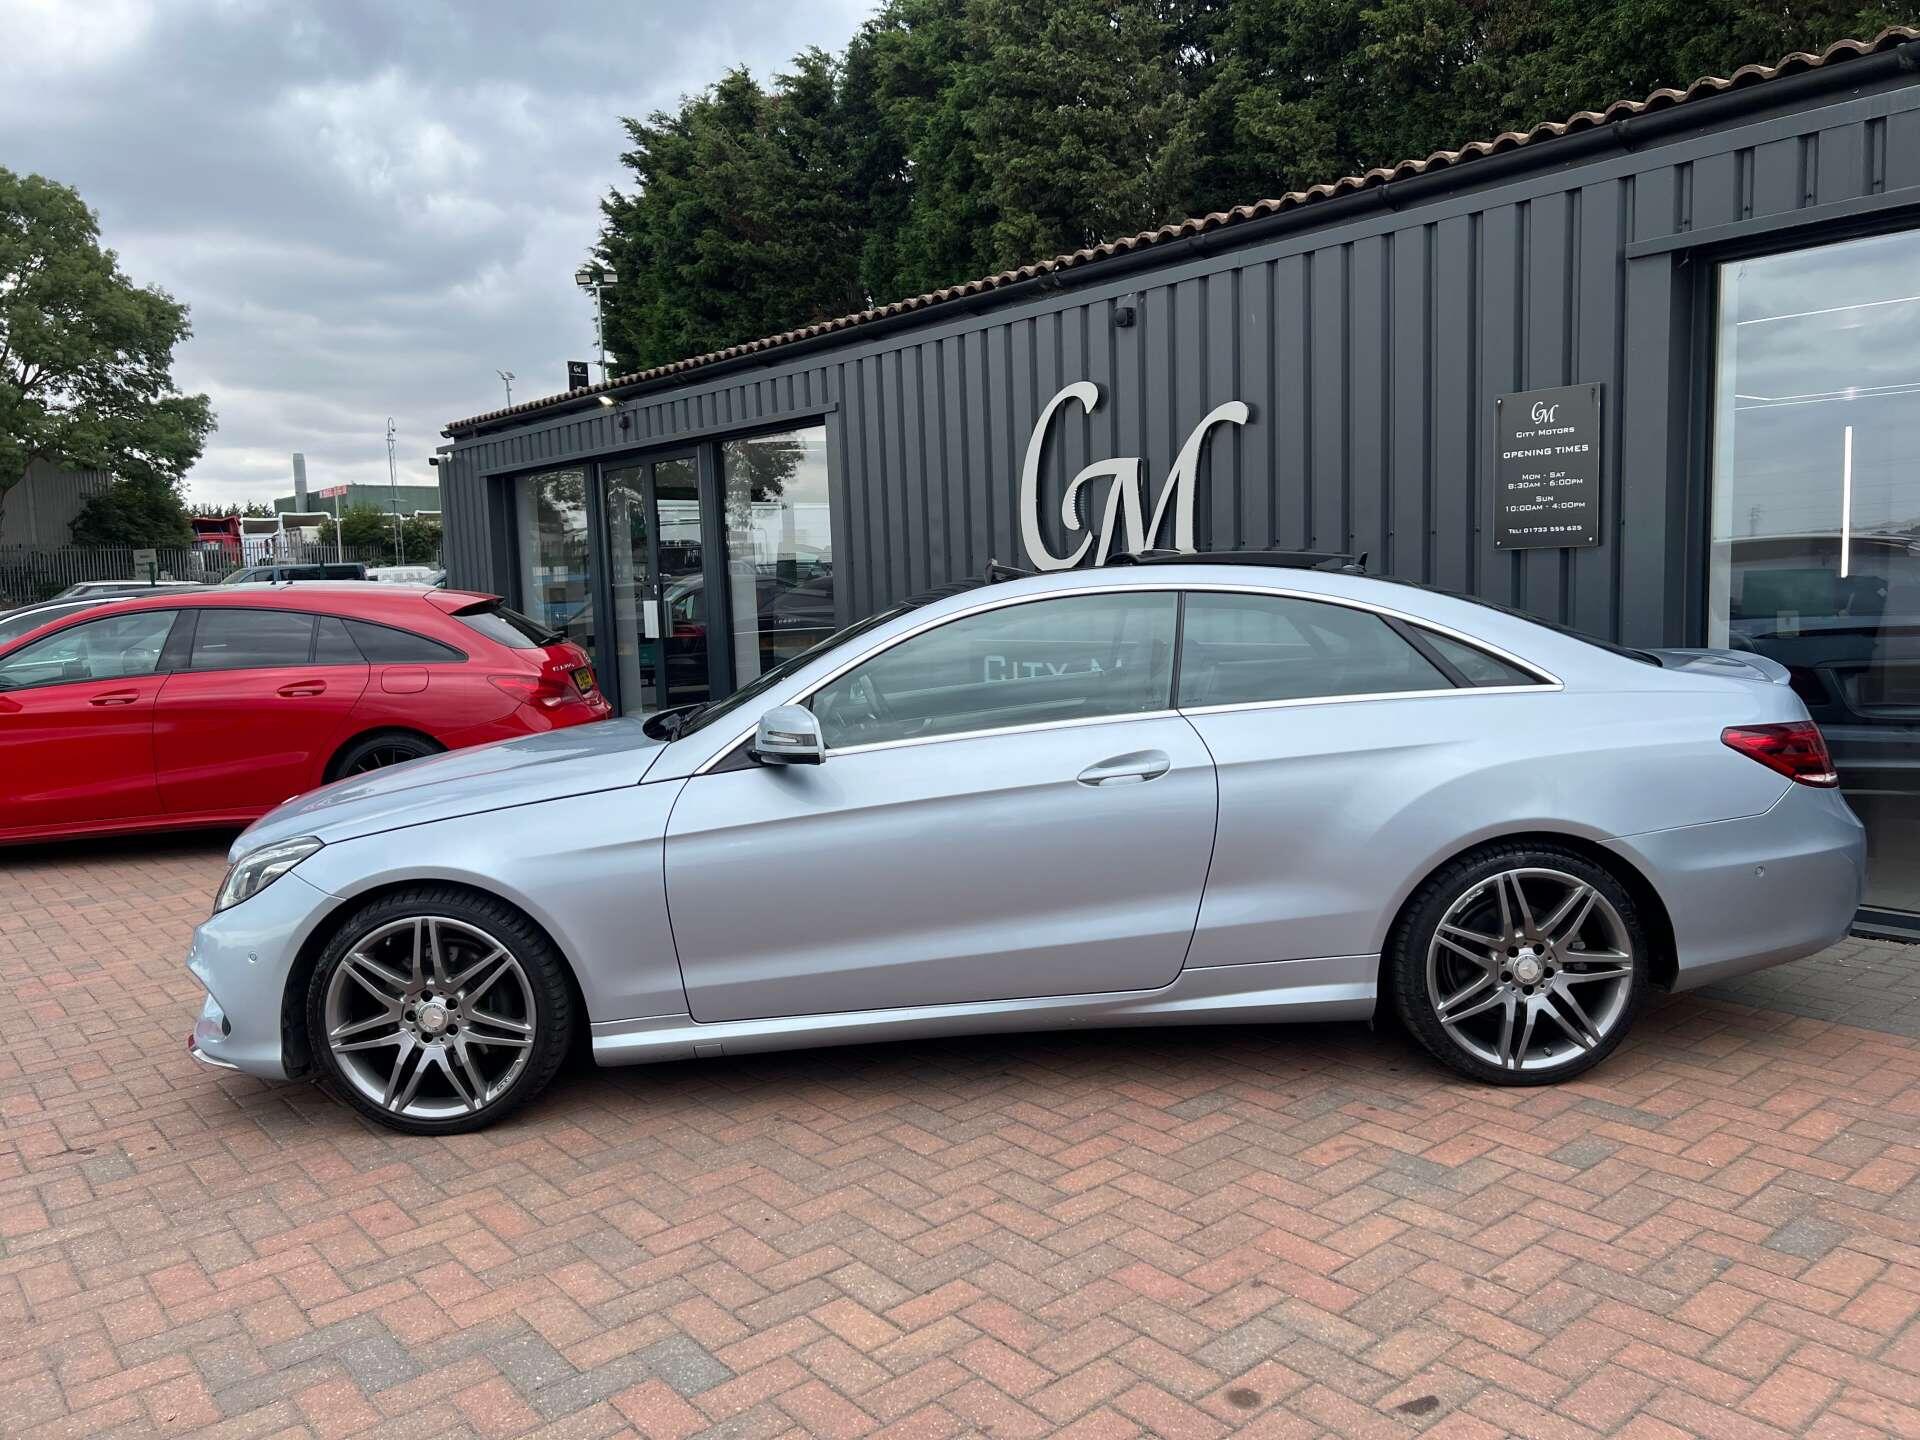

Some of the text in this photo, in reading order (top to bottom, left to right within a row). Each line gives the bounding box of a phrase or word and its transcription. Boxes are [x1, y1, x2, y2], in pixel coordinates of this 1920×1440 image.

[1538, 426, 1575, 436] MOTORS
[1503, 444, 1589, 459] OPENING TIMES
[1549, 478, 1583, 487] 6:00PM
[1505, 504, 1543, 512] 10:00AM
[1551, 501, 1586, 509] 4:00PM
